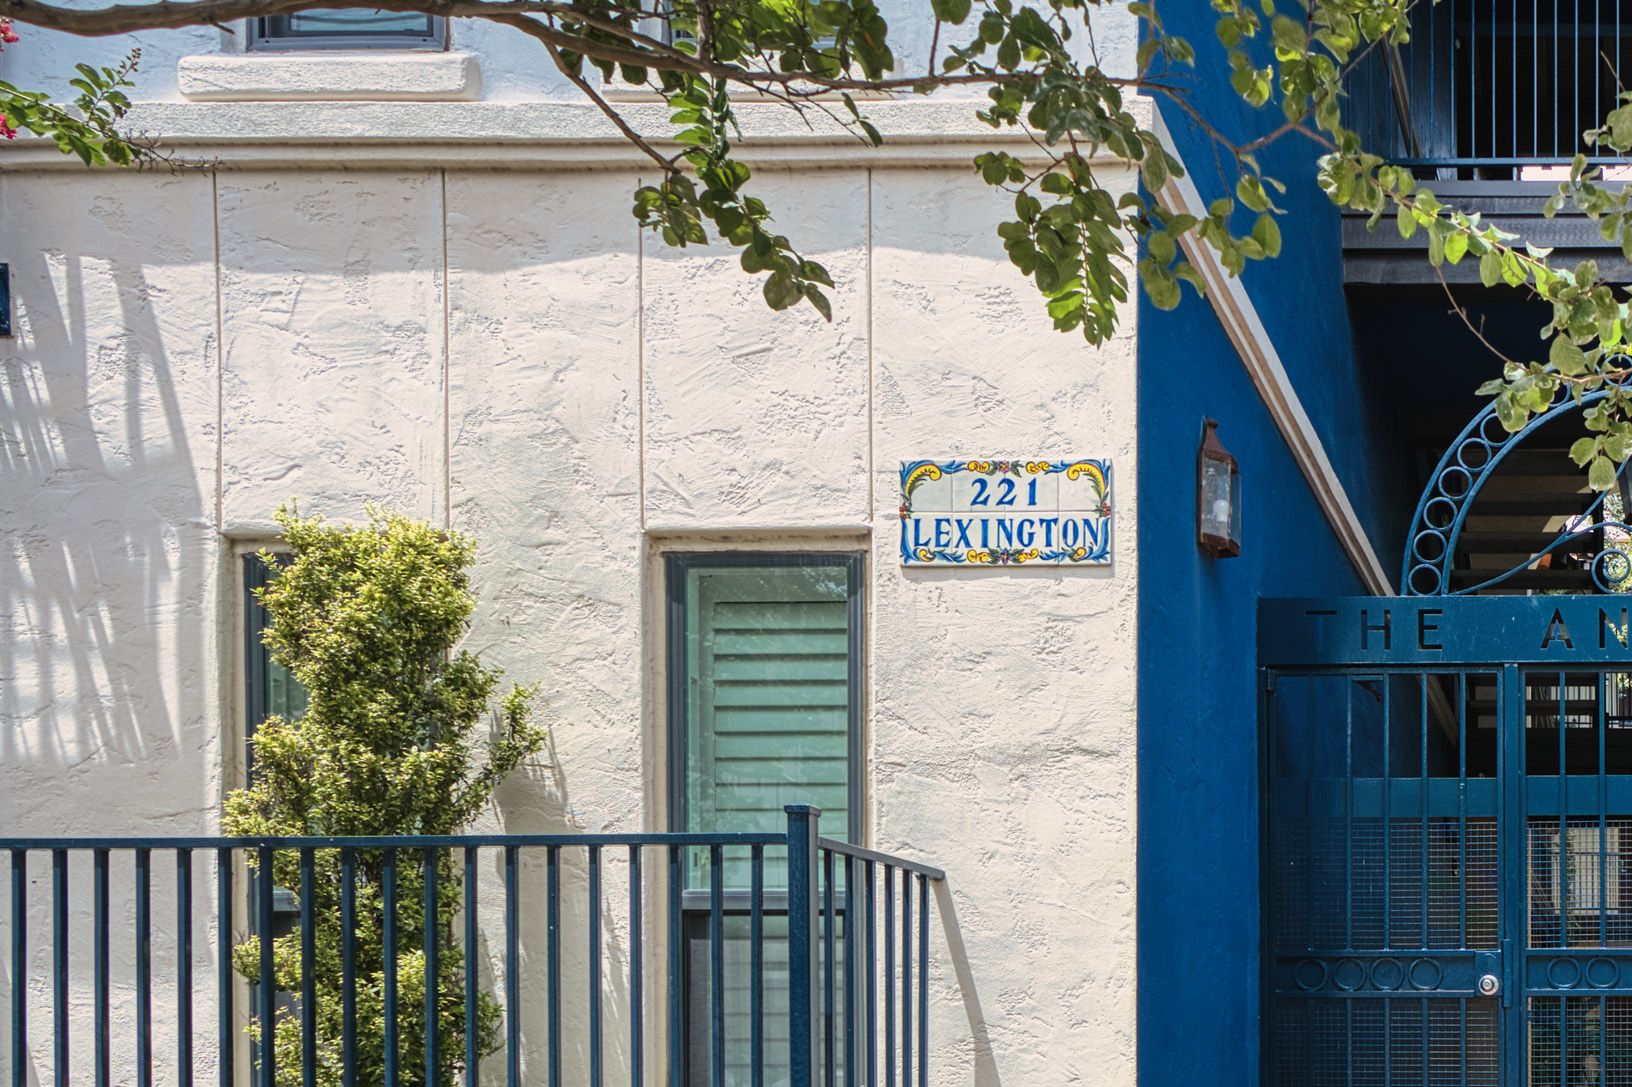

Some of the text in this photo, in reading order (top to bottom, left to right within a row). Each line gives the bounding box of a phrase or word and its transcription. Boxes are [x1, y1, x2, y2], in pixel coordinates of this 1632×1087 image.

[970, 477, 1038, 507] 221
[913, 517, 1100, 549] LEXINGTON
[1304, 607, 1444, 652] THE
